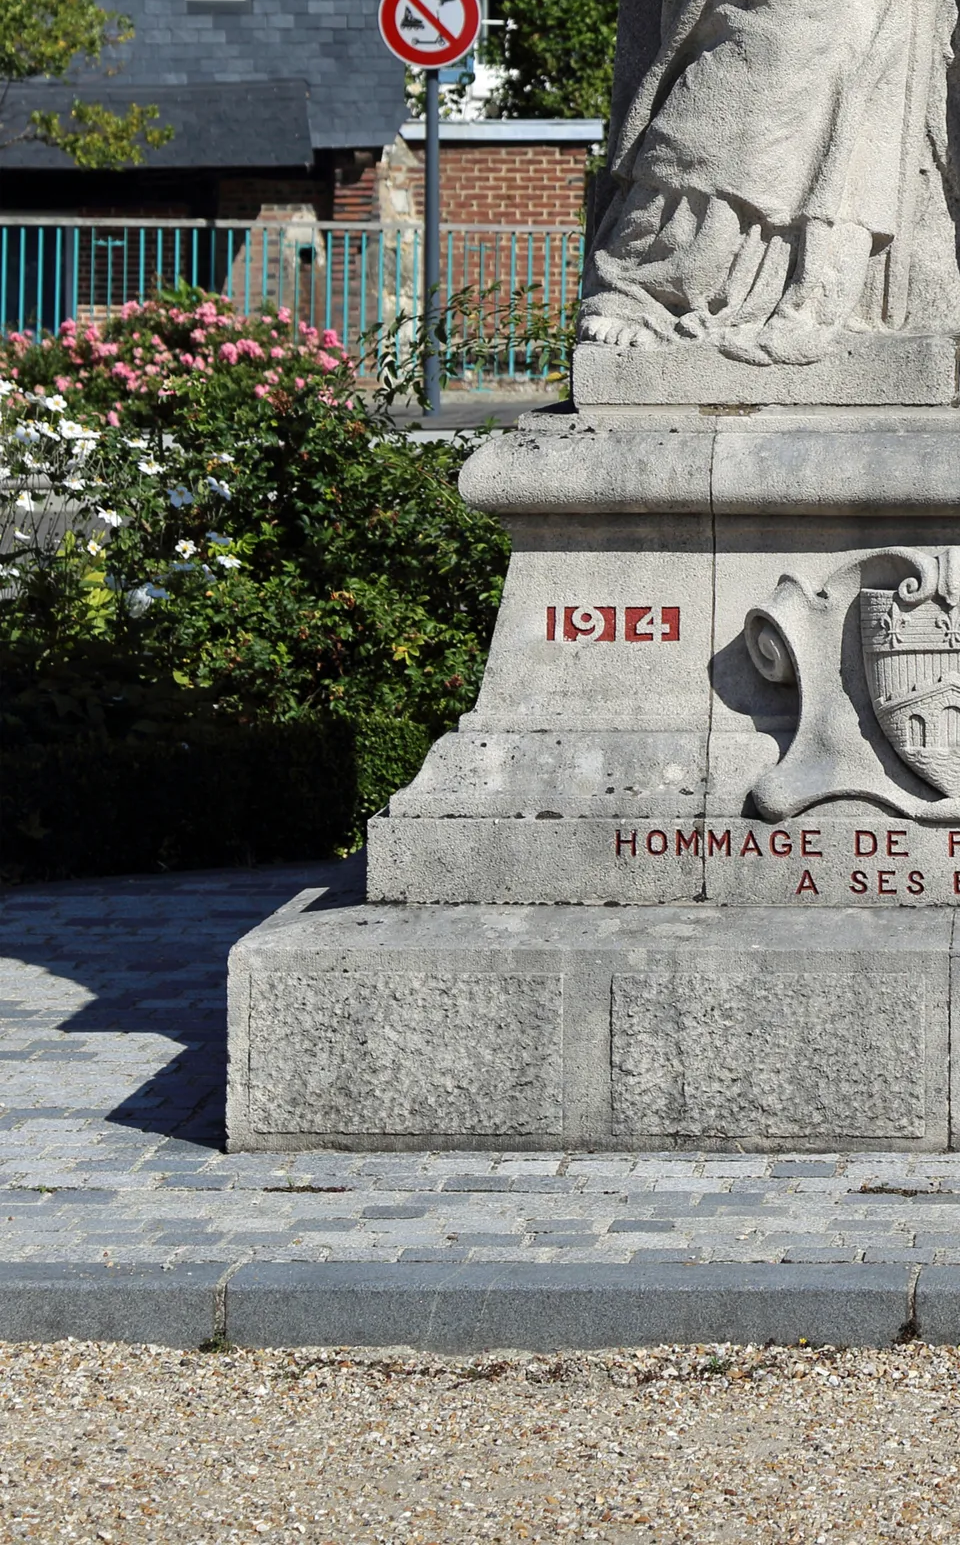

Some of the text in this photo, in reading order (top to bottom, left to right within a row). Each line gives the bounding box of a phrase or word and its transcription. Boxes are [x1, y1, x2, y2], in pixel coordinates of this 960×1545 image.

[553, 606, 671, 642] 1914
[614, 830, 823, 858] HOMMAGE
[854, 830, 909, 858] DE
[796, 870, 820, 896] A
[850, 870, 925, 896] SES
